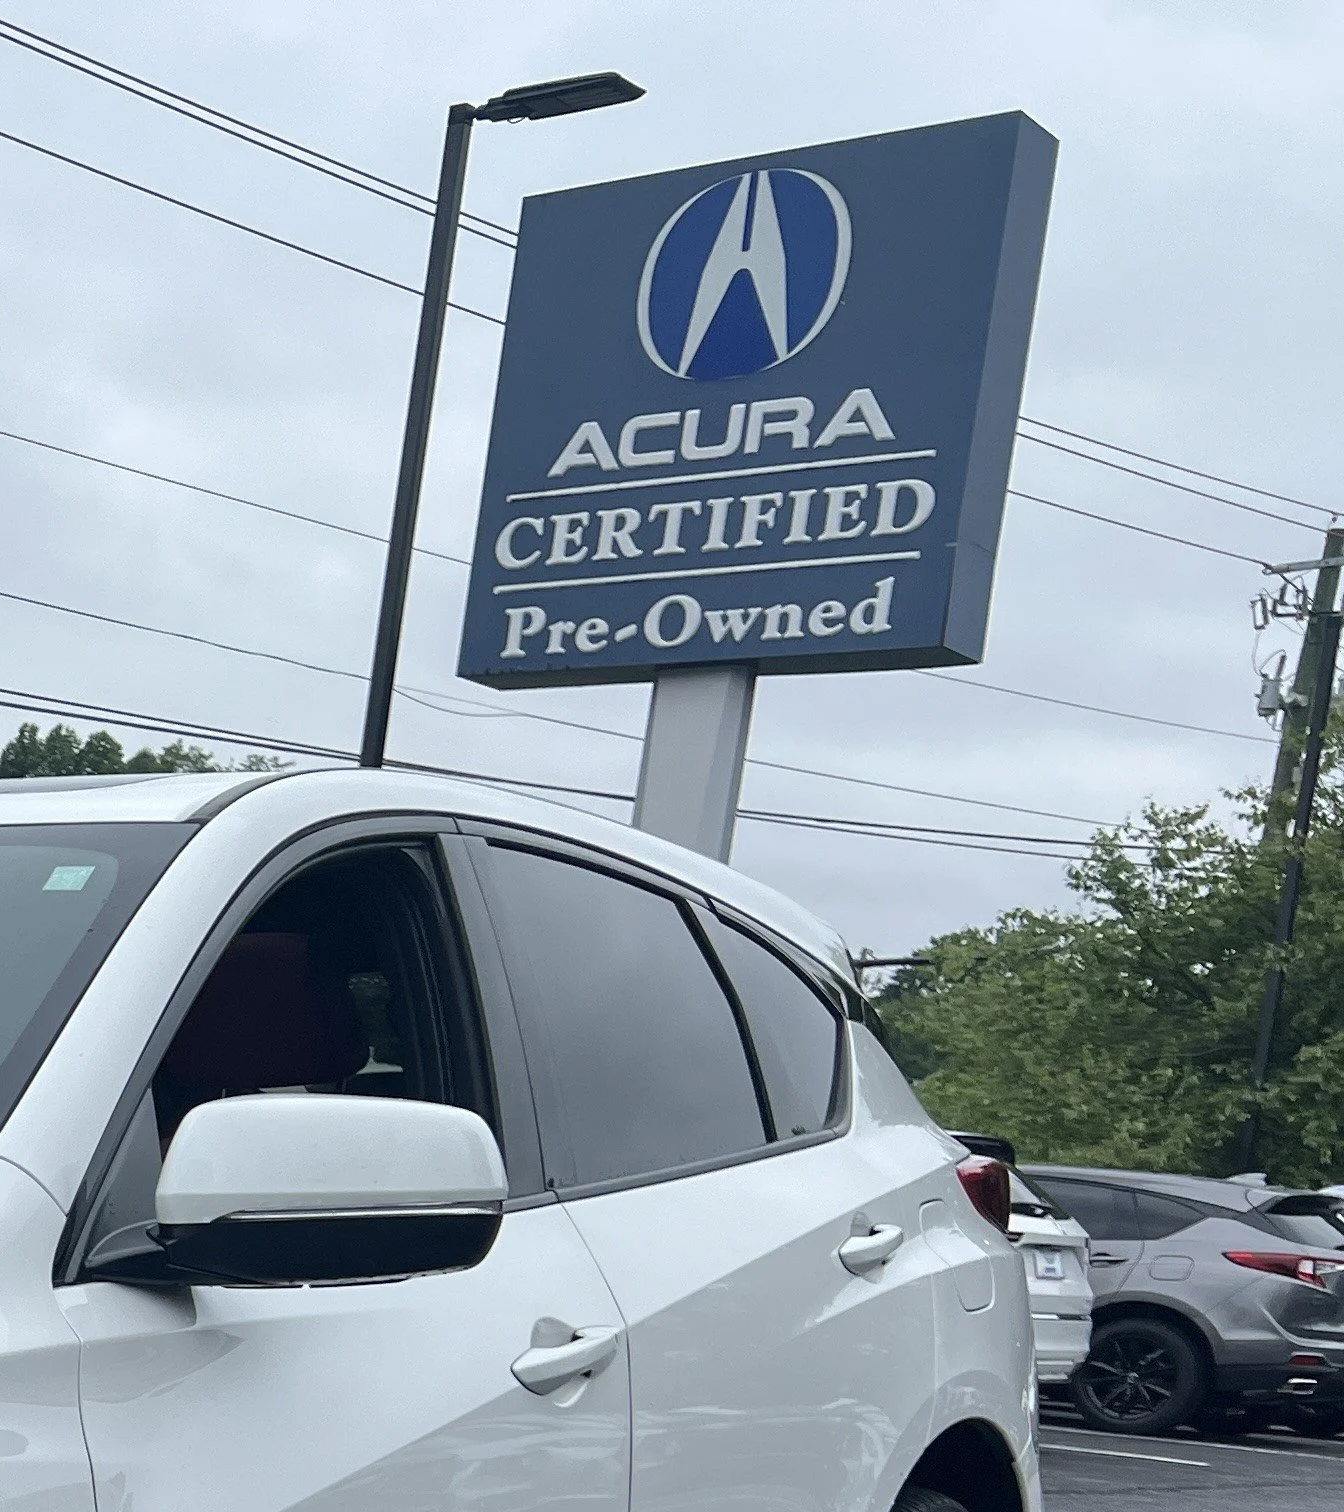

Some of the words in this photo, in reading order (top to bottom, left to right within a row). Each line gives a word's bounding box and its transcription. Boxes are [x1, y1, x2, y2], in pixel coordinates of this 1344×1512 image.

[547, 387, 897, 478] ACURA
[494, 477, 937, 571] CERTIFIED
[500, 576, 896, 659] Pre-Owned
